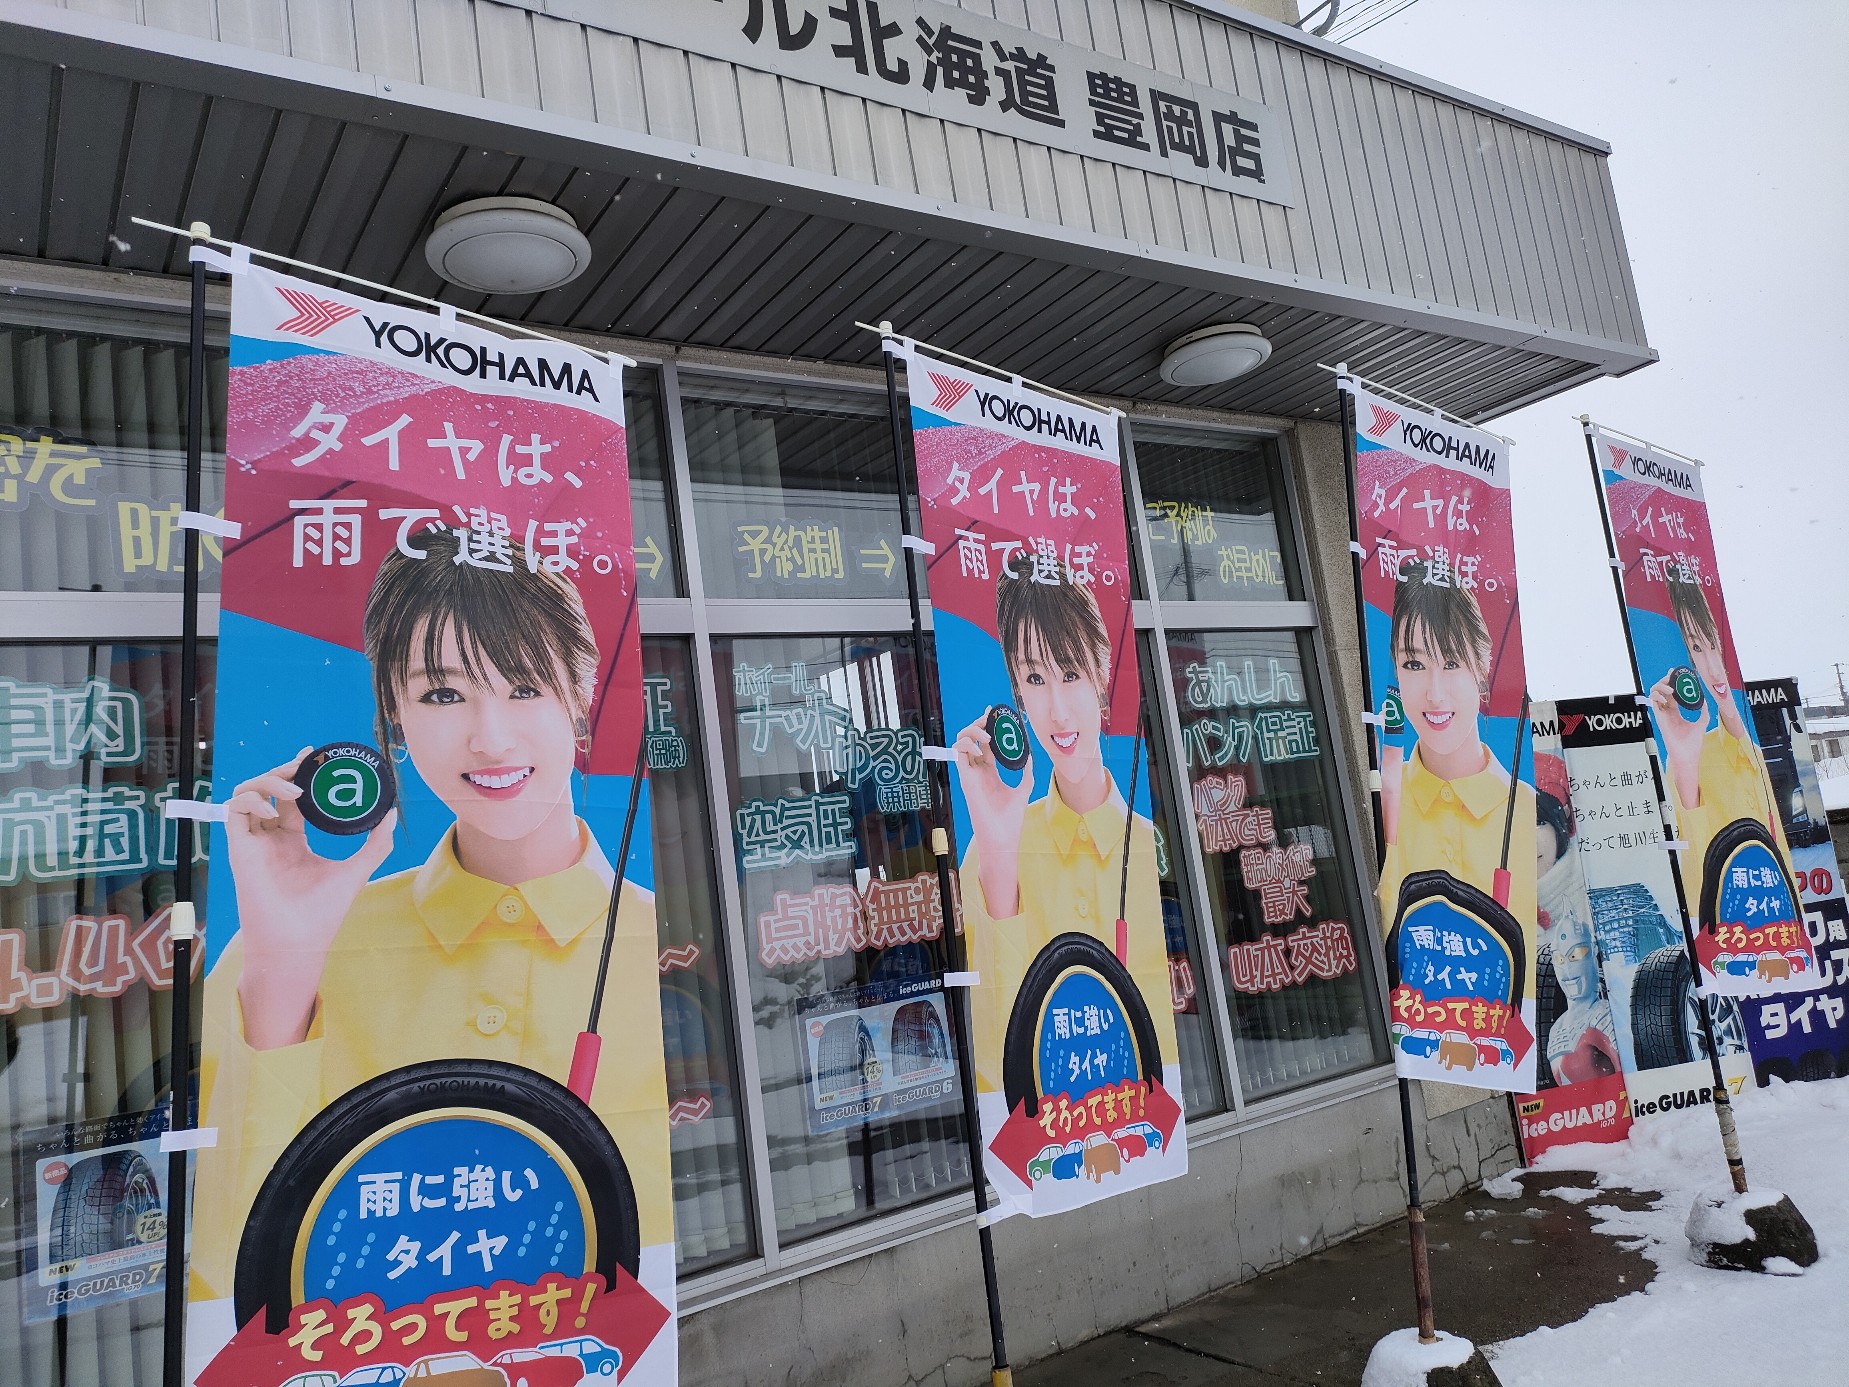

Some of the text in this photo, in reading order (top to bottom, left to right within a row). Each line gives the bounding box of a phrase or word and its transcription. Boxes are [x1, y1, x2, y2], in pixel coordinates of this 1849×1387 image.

[1085, 70, 1266, 185] 豊岡店
[362, 314, 600, 403] YOKOHAMA
[974, 389, 1104, 450] YOKOHAMA
[290, 401, 584, 490] タイヤは、
[1401, 419, 1496, 476] YOKOHAMA
[946, 461, 1096, 520] タイヤは、
[1629, 454, 1695, 492] YOKOHAMA
[1145, 500, 1217, 545] ご予約は
[1372, 480, 1480, 536] タイヤは、
[288, 499, 612, 576] 雨で選ぼ。
[737, 525, 844, 579] 予約制
[954, 528, 1115, 586] 雨で選ぼ。
[1218, 546, 1285, 587] お早めに
[1375, 537, 1498, 591] 雨で選ぼ。
[733, 662, 814, 696] ホイール
[1185, 659, 1300, 708] あんしん
[1682, 678, 1697, 698] a
[740, 692, 850, 753] ナット
[1002, 722, 1019, 751] a
[325, 747, 380, 769] YOKOHAMA
[327, 768, 364, 807] a
[1194, 774, 1245, 813] パンク
[1568, 770, 1655, 792] ちゃんと曲が
[1198, 807, 1275, 852] 1本でも
[1573, 800, 1673, 822] ちゃんと止ま。
[736, 796, 857, 869] 空気圧
[1578, 826, 1679, 852] だって旭川生
[1732, 866, 1781, 889] 雨に強い
[761, 871, 963, 964] 点検無料
[1262, 881, 1312, 922] 最大
[1745, 896, 1780, 917] タイヤ
[1407, 925, 1488, 957] 雨に強い
[900, 978, 942, 995] iceGUARD
[1424, 961, 1478, 991] タイヤ
[1052, 1004, 1114, 1040] 雨に強い
[1394, 989, 1511, 1035] そろってます!
[1760, 993, 1845, 1040] タイヤ
[1068, 1048, 1108, 1083] タイヤ
[415, 1078, 507, 1097] YOKOHAMA
[819, 1094, 835, 1104] NEW
[893, 1083, 942, 1106] iceGUARD
[942, 1079, 953, 1094] 6
[1522, 1101, 1541, 1114] NEW
[1633, 1075, 1747, 1119] iceGUAR 7
[820, 1096, 882, 1124] iceGUARD 7
[1038, 1085, 1146, 1138] そろってます!
[1522, 1099, 1617, 1139] iceGUARD
[1600, 1118, 1616, 1129] iG70
[357, 1164, 540, 1219] 雨に強い
[48, 1263, 77, 1277] NEW
[386, 1229, 509, 1280] タイヤ
[46, 1263, 166, 1306] iceGUARD 7
[288, 1282, 598, 1362] そろってます!
